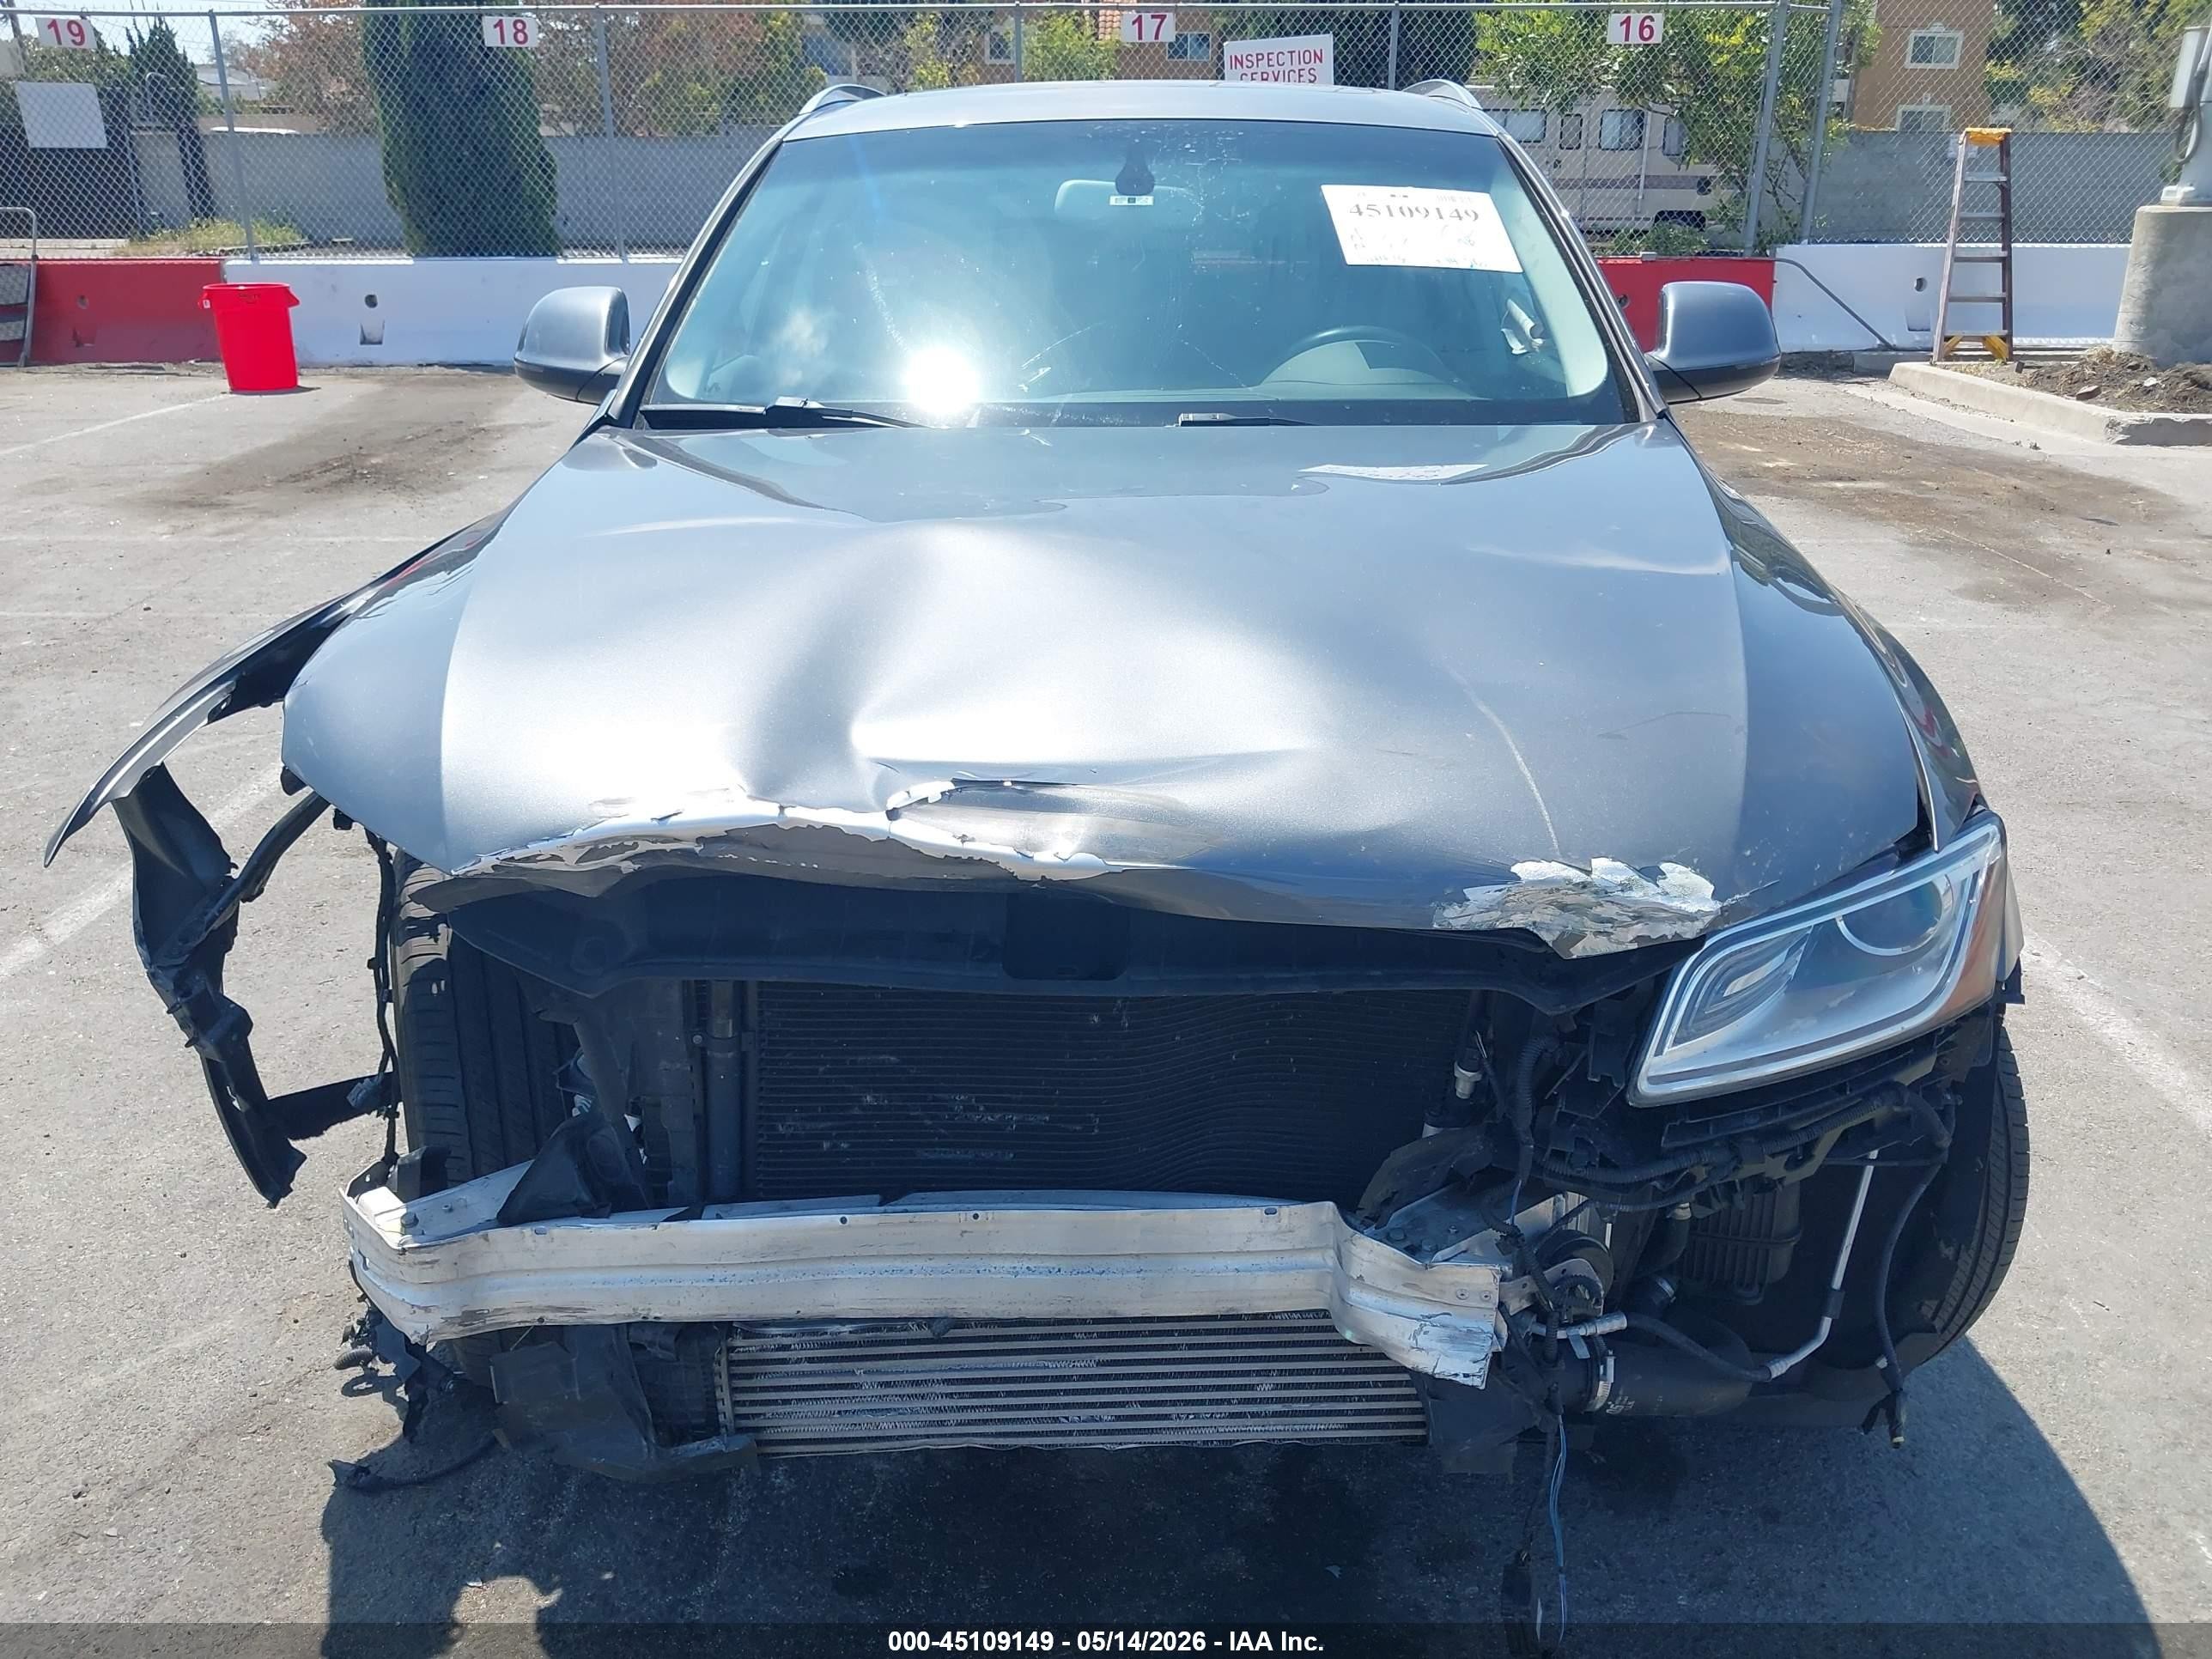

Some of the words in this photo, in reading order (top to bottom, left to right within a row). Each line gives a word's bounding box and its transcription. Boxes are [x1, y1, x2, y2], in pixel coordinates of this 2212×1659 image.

[47, 19, 86, 46] 19
[493, 19, 529, 46] 18
[1131, 14, 1168, 41] 17
[1619, 15, 1656, 42] 16
[1229, 48, 1323, 70] INSPECTION
[1349, 204, 1480, 222] 45109149
